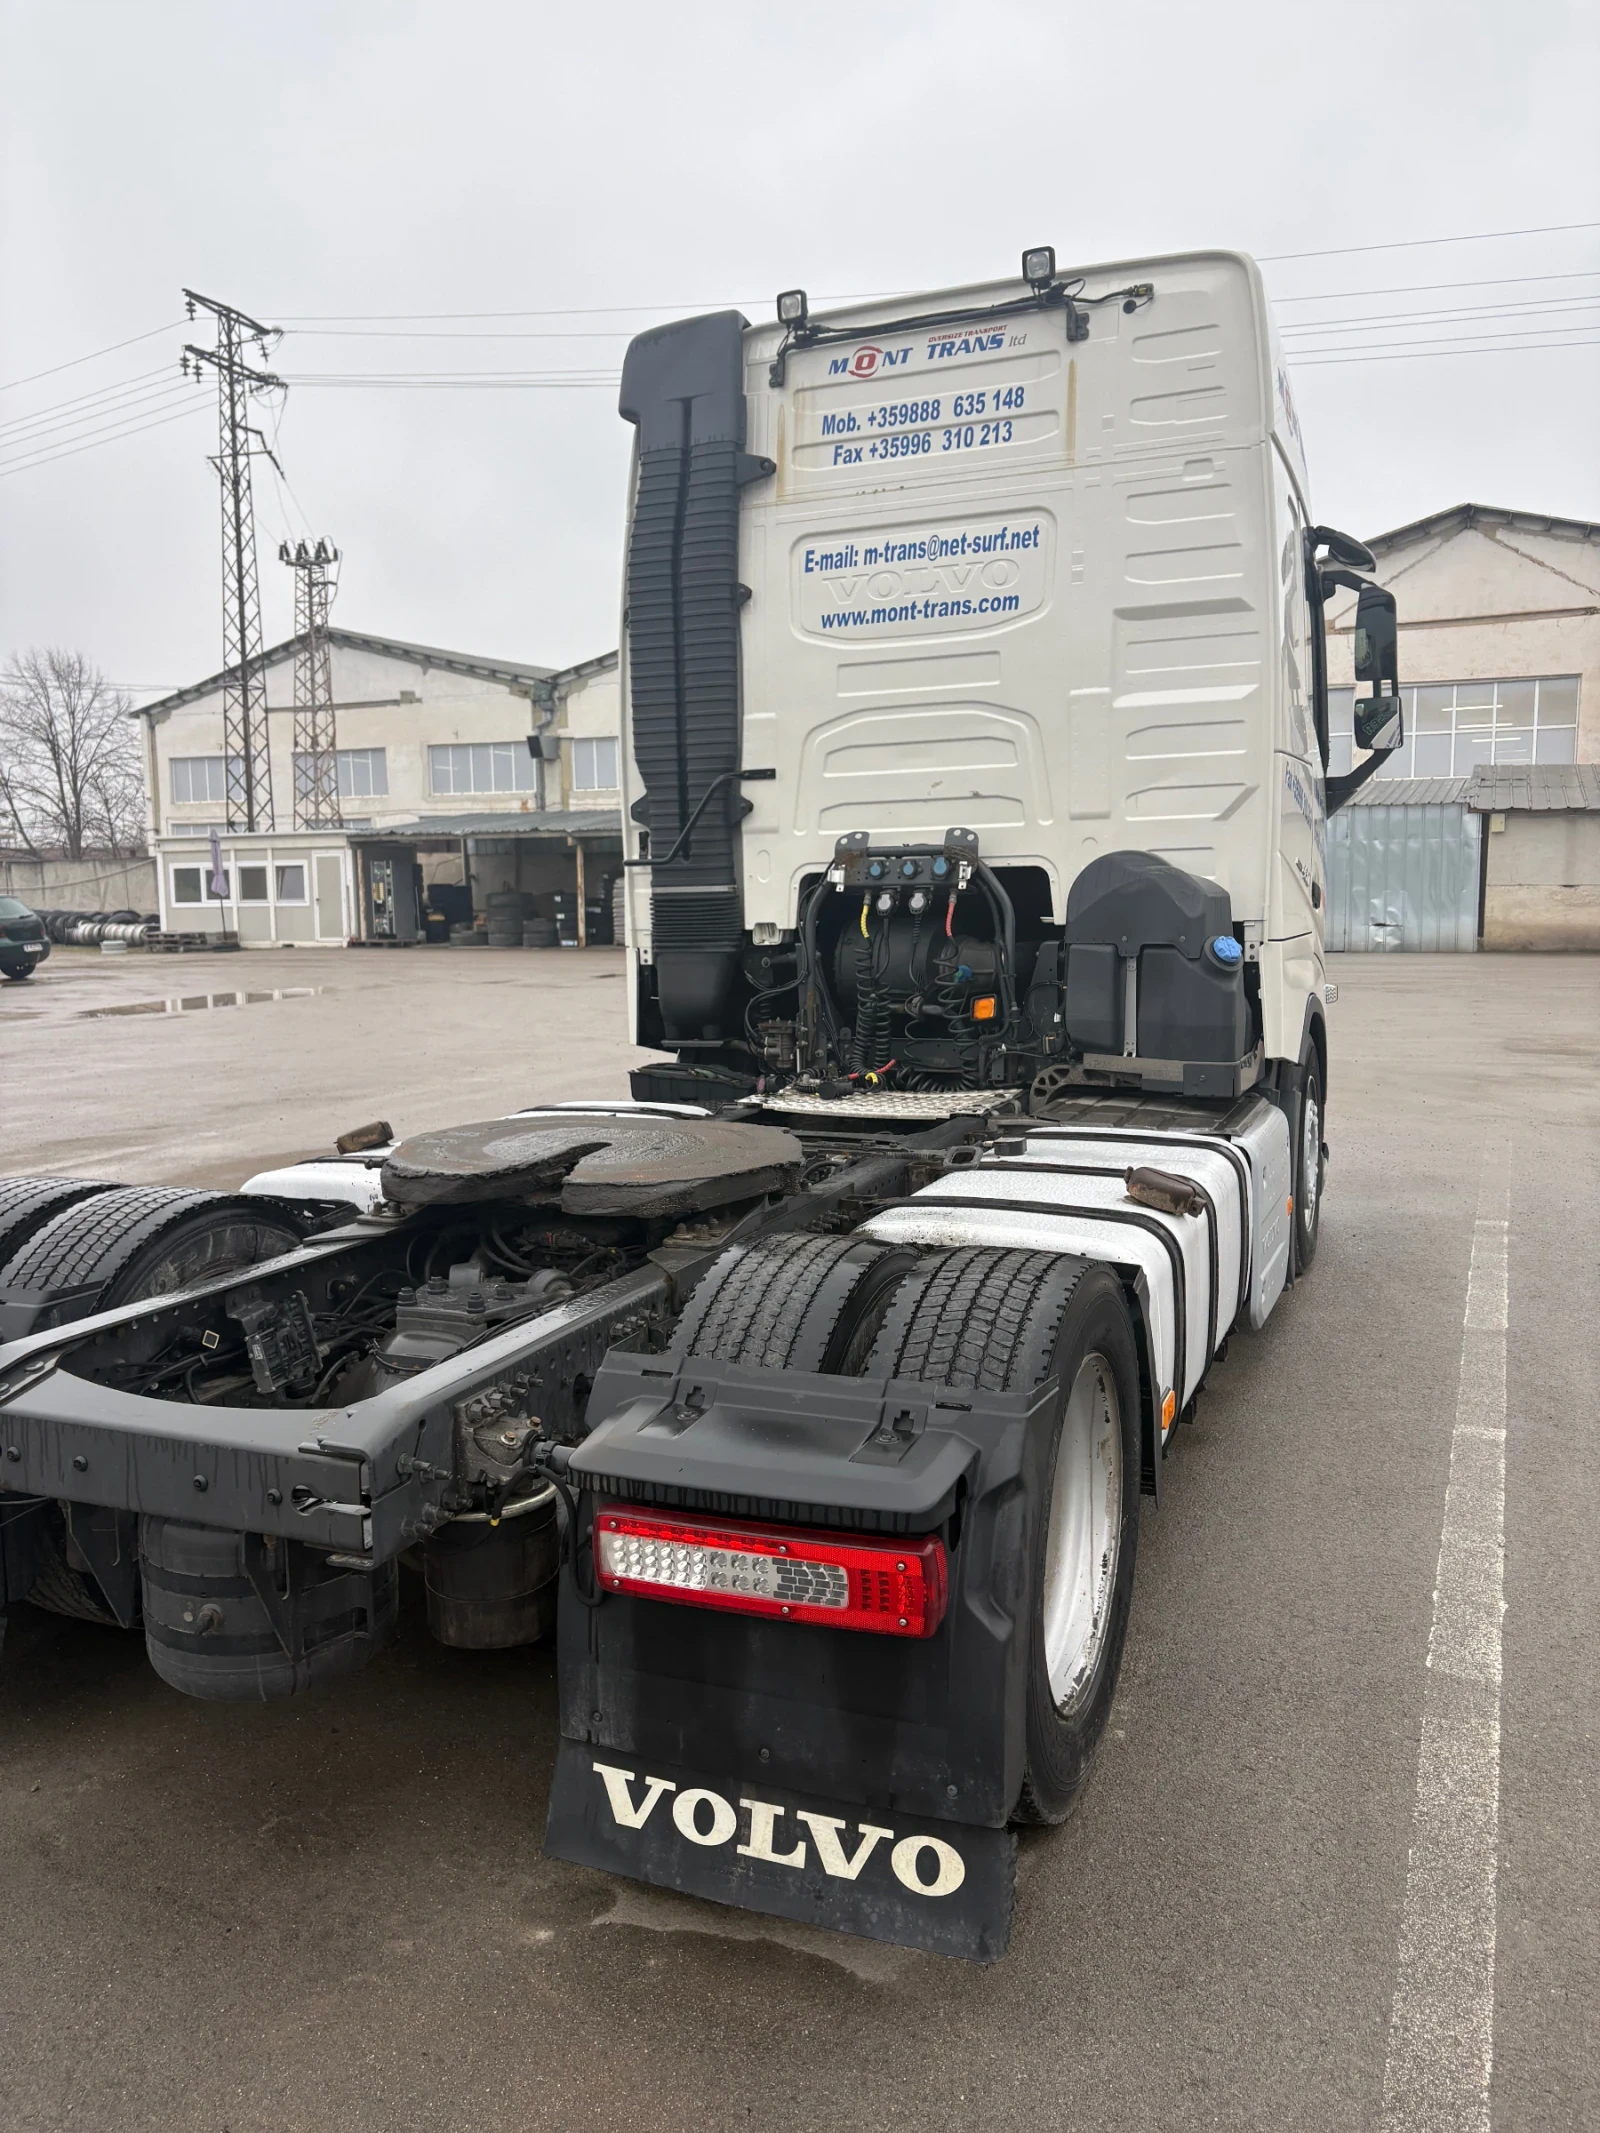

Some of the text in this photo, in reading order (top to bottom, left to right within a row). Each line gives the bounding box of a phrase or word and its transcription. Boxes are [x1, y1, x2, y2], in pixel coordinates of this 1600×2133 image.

[828, 333, 1028, 378] MONT TRANS ltd
[928, 324, 1008, 343] OVERSIZE TRANSPORT
[821, 386, 1025, 436] Mob. +359888 635 148
[833, 420, 1013, 466] Fax +35996 310 213
[804, 524, 1040, 573] E-mail: m-trans@net-surf.net
[821, 558, 1021, 605] VOLVO
[820, 594, 1020, 629] www.mont-trans.com
[592, 1761, 966, 1897] VOLVO
